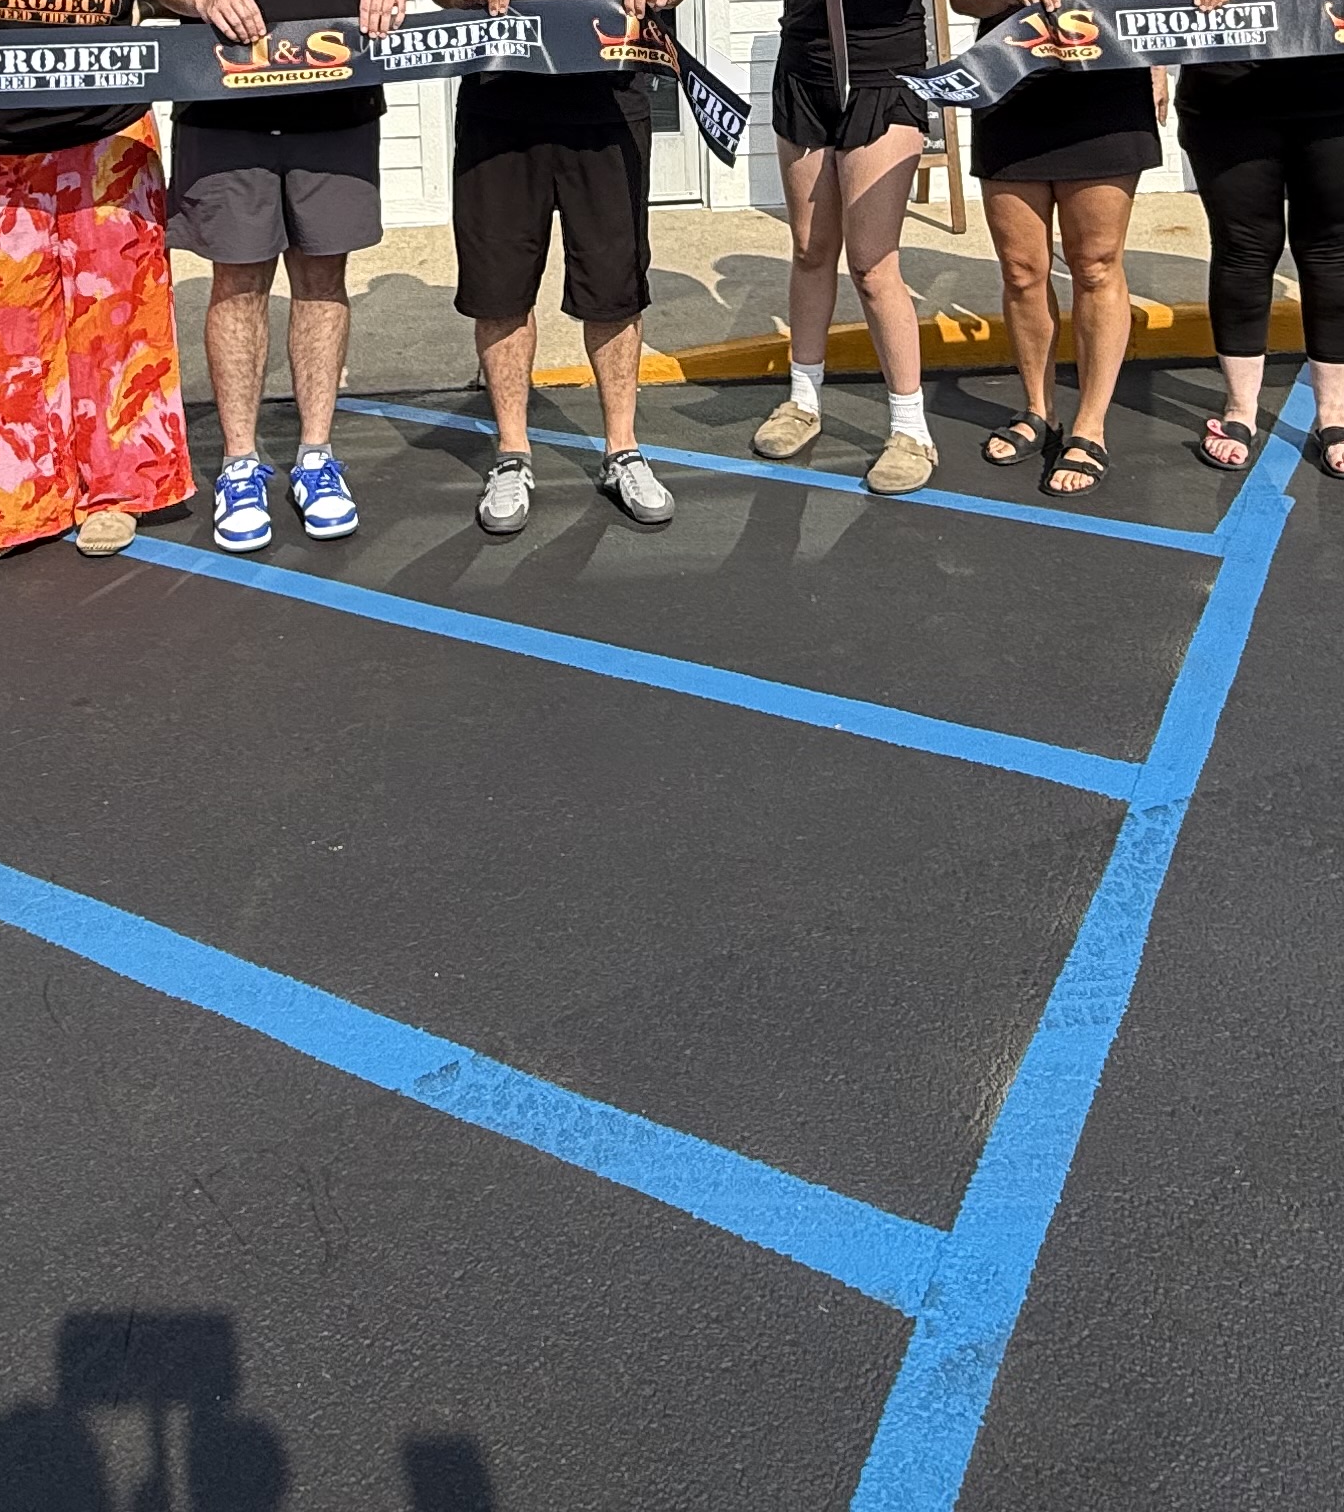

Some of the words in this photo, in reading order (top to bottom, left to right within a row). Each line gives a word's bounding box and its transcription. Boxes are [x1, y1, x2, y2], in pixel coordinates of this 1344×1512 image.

[1125, 5, 1267, 35] PROJECT
[378, 20, 531, 56] PROJECT
[1136, 36, 1176, 50] FEED
[1184, 33, 1217, 46] THE
[1223, 29, 1263, 44] KIDS
[214, 30, 352, 73] J&S
[389, 53, 433, 69] FEED
[442, 48, 476, 63] THE
[485, 42, 526, 56] KIDS
[610, 46, 672, 63] HAMBU
[46, 75, 85, 88] THE
[95, 73, 140, 87] KIDS
[233, 69, 344, 85] HAMBURG
